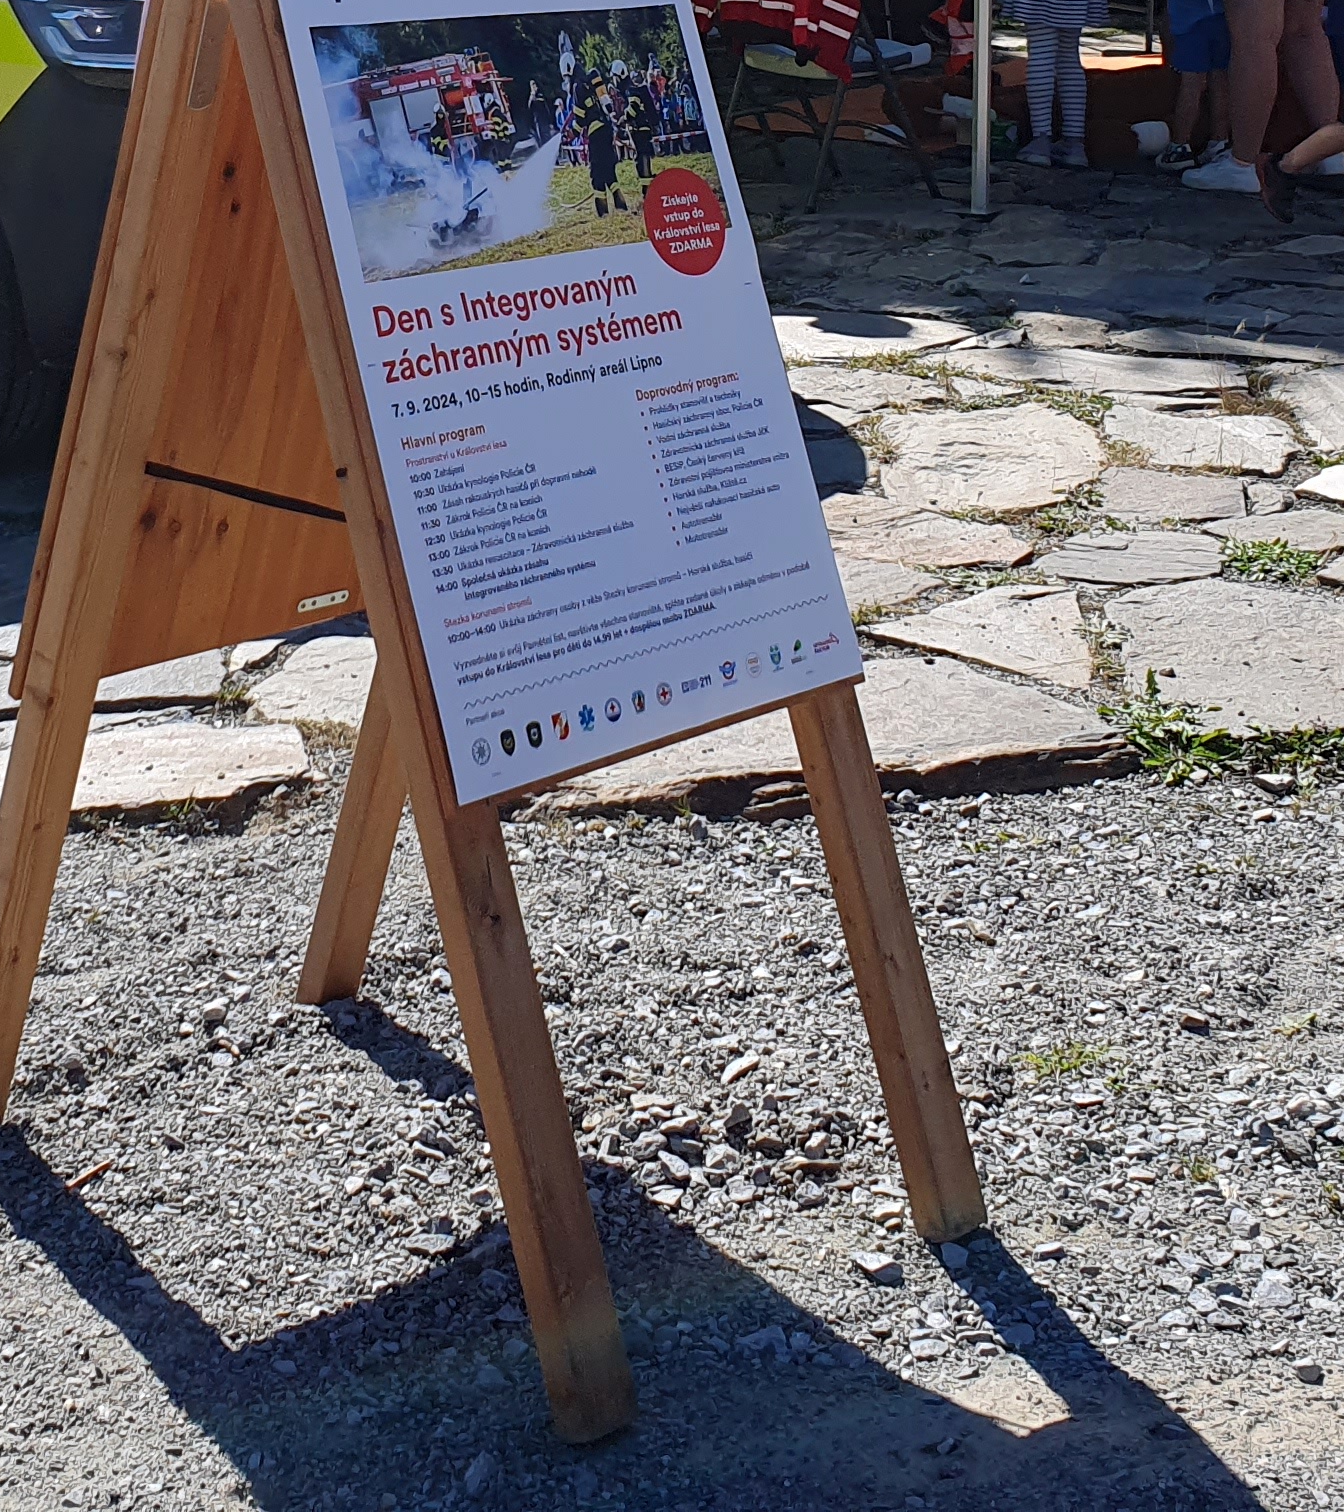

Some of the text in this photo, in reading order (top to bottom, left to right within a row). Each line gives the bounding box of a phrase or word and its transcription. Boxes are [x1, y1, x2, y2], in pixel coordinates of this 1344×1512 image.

[663, 207, 704, 223] vstup do
[653, 221, 721, 241] Království lesa
[669, 236, 714, 254] ZDARMA
[372, 270, 636, 337] Den s Integrovaným
[382, 310, 682, 383] záchranným systémem
[391, 403, 404, 418] 7.
[406, 400, 420, 415] 9.
[422, 392, 462, 412] 2024,
[503, 376, 544, 395] hodin,
[546, 364, 595, 387] Rodinný
[599, 358, 628, 377] areál
[629, 355, 662, 372] Lipno
[635, 372, 739, 401] Doprovodný program:
[400, 425, 485, 450] Hlavní program
[409, 471, 431, 483] 10:00
[413, 487, 434, 499] 10:30
[417, 503, 437, 515] 11:00
[529, 478, 539, 490] při
[420, 518, 440, 530] 11:30
[424, 533, 445, 546] 12:30
[428, 549, 450, 562] 13:00
[431, 565, 453, 577] 13:30
[435, 580, 458, 594] 14:00
[485, 667, 495, 677] do
[552, 647, 565, 659] pro
[582, 638, 592, 648] do
